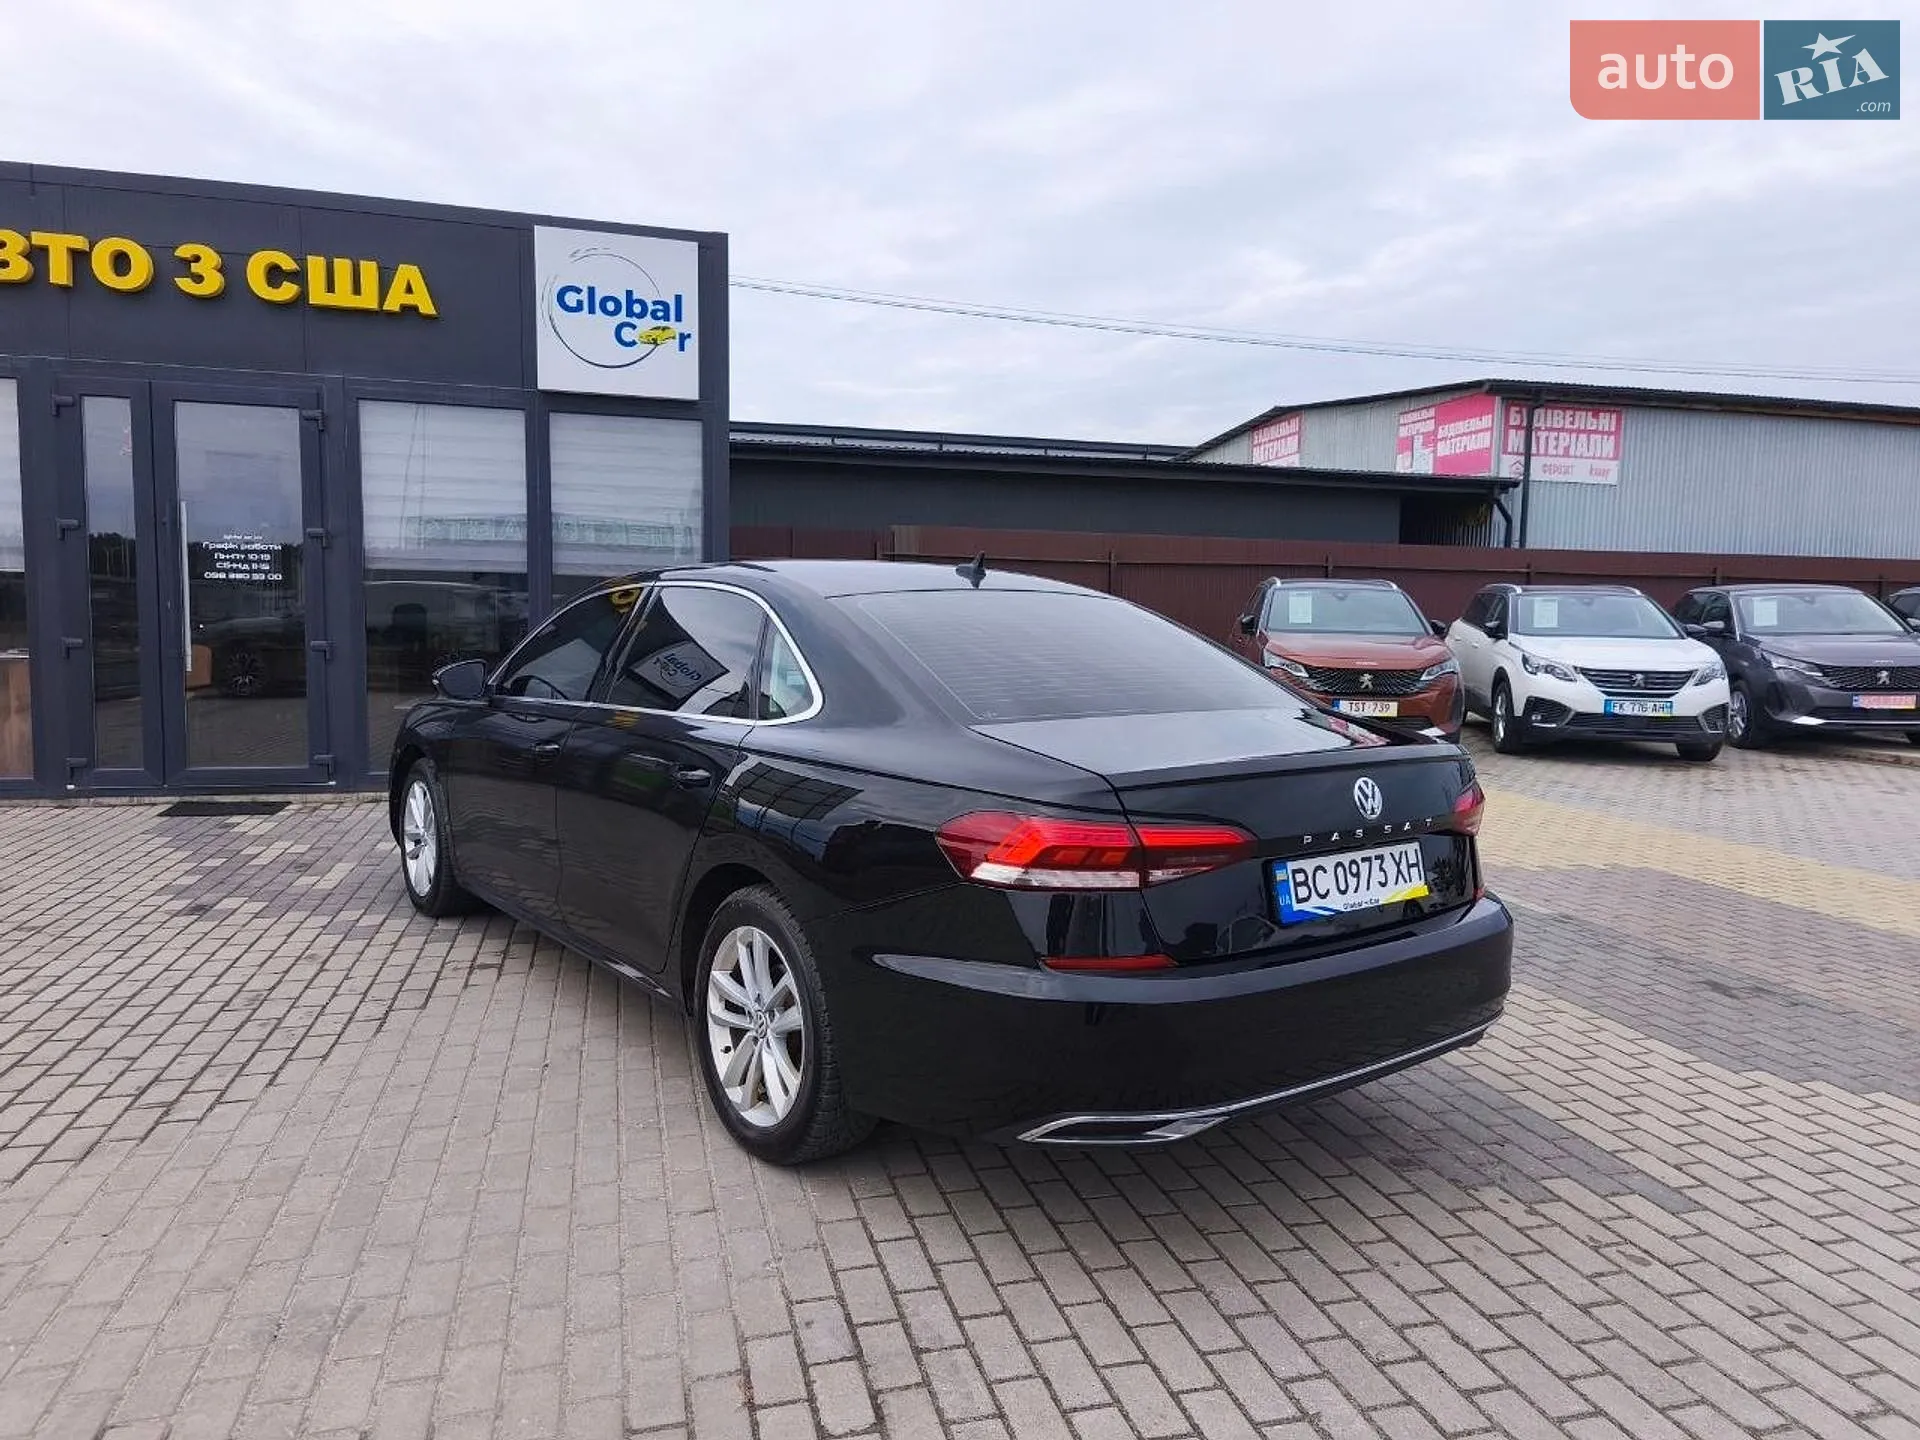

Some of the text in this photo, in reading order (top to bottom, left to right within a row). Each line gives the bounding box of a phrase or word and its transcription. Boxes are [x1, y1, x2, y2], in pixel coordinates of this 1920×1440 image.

[246, 249, 439, 318] США
[556, 285, 683, 323] Global
[614, 321, 691, 352] Cr
[1303, 818, 1433, 844] PASSAT
